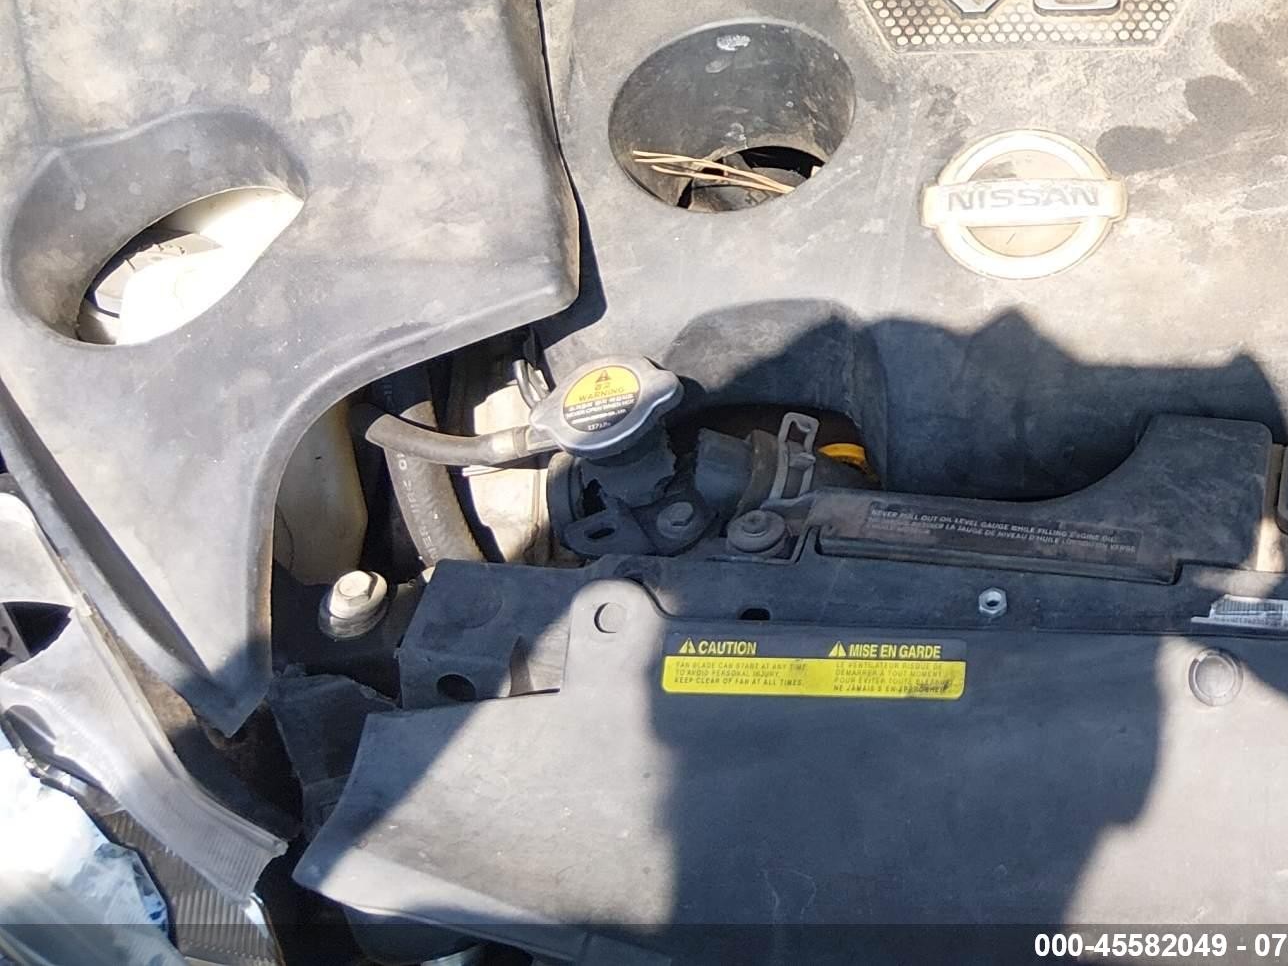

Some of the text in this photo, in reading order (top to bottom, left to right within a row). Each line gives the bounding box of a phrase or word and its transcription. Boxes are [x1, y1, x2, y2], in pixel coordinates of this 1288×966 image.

[948, 187, 1099, 211] NISSAN
[579, 386, 624, 401] WARNING
[871, 509, 898, 518] NEVER
[920, 514, 938, 523] OUT
[954, 517, 978, 527] LEVEL
[980, 521, 1009, 531] GAUGE
[1037, 528, 1067, 537] FILLING
[945, 523, 956, 531] LA
[957, 525, 983, 535] JAUGE
[984, 529, 996, 537] DE
[997, 531, 1028, 540] NIVEAU
[698, 640, 757, 655] CAUTION
[850, 644, 941, 658] MISE EN GARDE
[674, 675, 693, 683] KEEP
[695, 676, 720, 684] CLEAR
[751, 677, 761, 685] AT
[711, 669, 750, 677] PERSONAL
[833, 675, 855, 683] POUR
[833, 683, 843, 691] NE
[846, 683, 874, 691] JAMAIS
